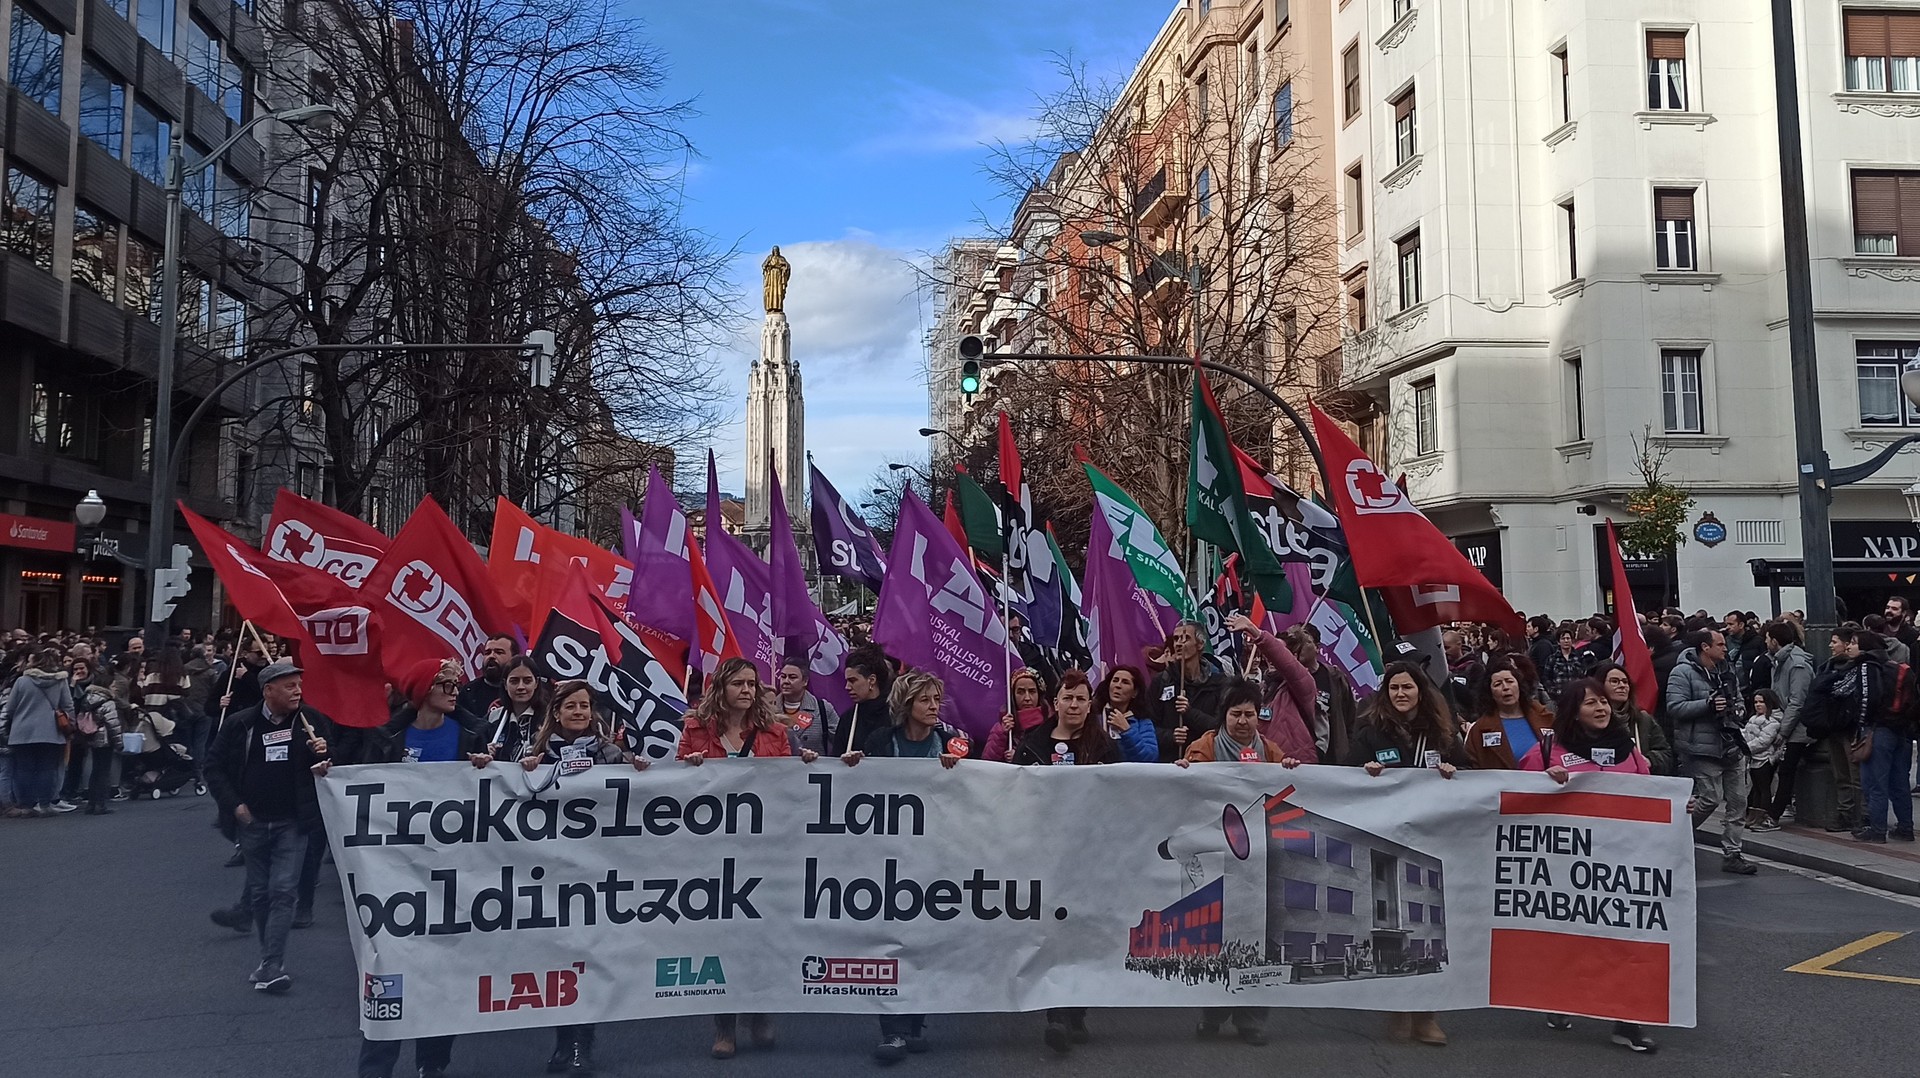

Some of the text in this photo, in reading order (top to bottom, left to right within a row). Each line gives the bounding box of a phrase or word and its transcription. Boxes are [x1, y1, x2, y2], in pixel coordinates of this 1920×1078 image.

[18, 524, 48, 540] Santander
[1468, 546, 1487, 566] NAP
[1863, 537, 1917, 558] NAP
[343, 773, 925, 848] Irakasleon lan
[1495, 825, 1591, 856] HEMEN
[1495, 857, 1672, 897] ETA ORAIN
[347, 857, 1068, 939] baldintzak hobetu.
[1494, 889, 1668, 931] ERABAKITA
[656, 956, 726, 987] ELA
[830, 963, 894, 980] CCOO
[655, 990, 682, 998] EUSKAL
[803, 984, 898, 997] irakaskuntza
